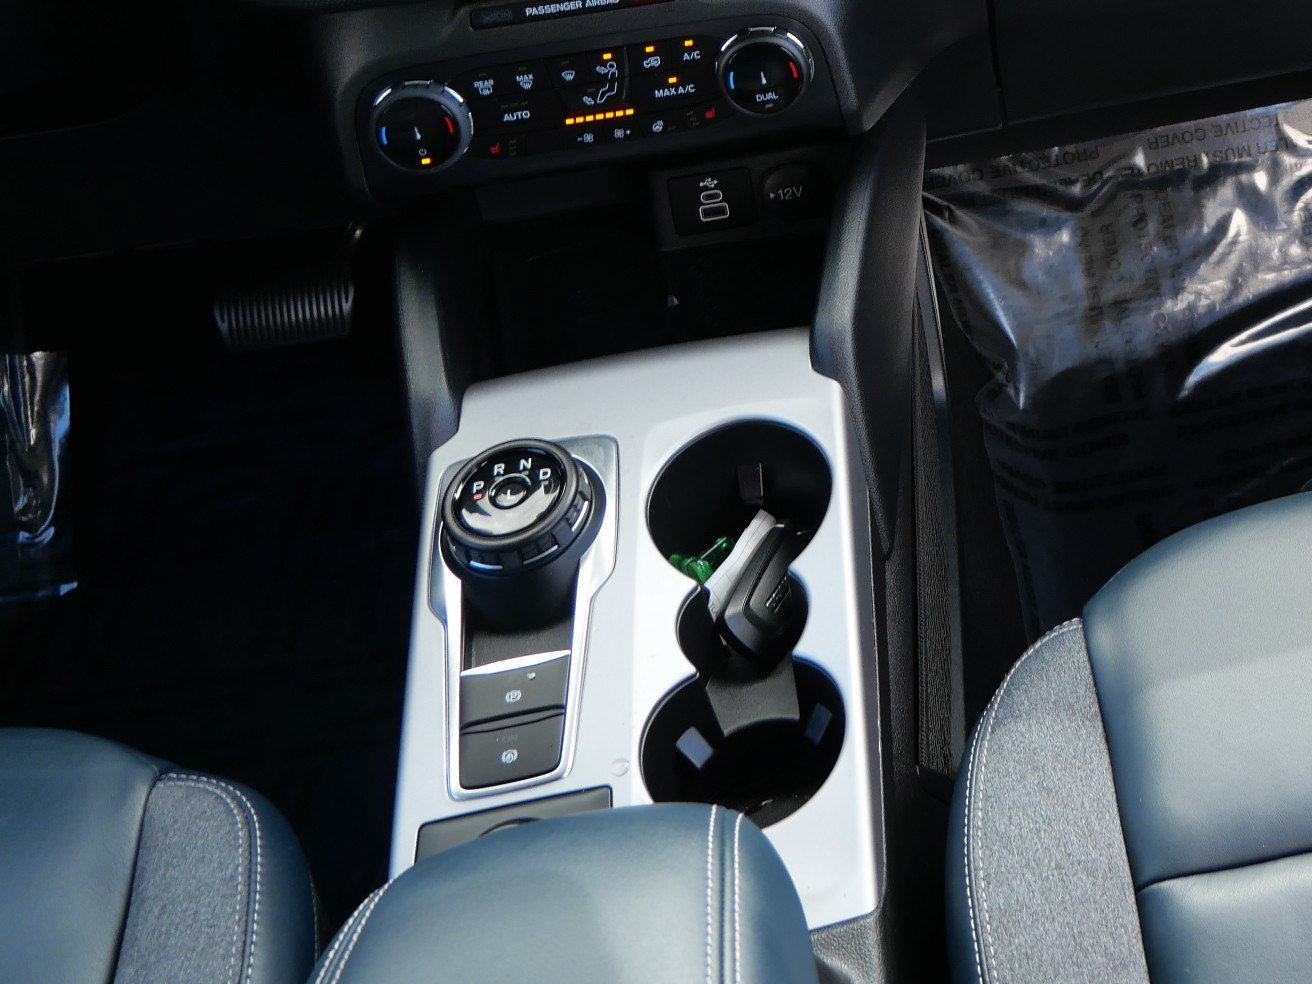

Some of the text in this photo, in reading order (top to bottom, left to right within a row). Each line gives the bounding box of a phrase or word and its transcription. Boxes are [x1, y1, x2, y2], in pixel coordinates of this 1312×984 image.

[525, 0, 583, 17] PASSENGER
[683, 50, 702, 62] A/C
[473, 78, 494, 89] REAR
[516, 72, 534, 83] MAX
[654, 83, 696, 99] MAX A/C
[755, 91, 780, 103] DUAL
[503, 110, 531, 123] AUTO
[1147, 127, 1206, 150] COVER
[777, 185, 803, 200] 12V
[493, 463, 505, 476] R
[520, 457, 532, 471] N
[539, 467, 552, 481] D
[472, 480, 485, 494] P
[506, 488, 516, 501] L
